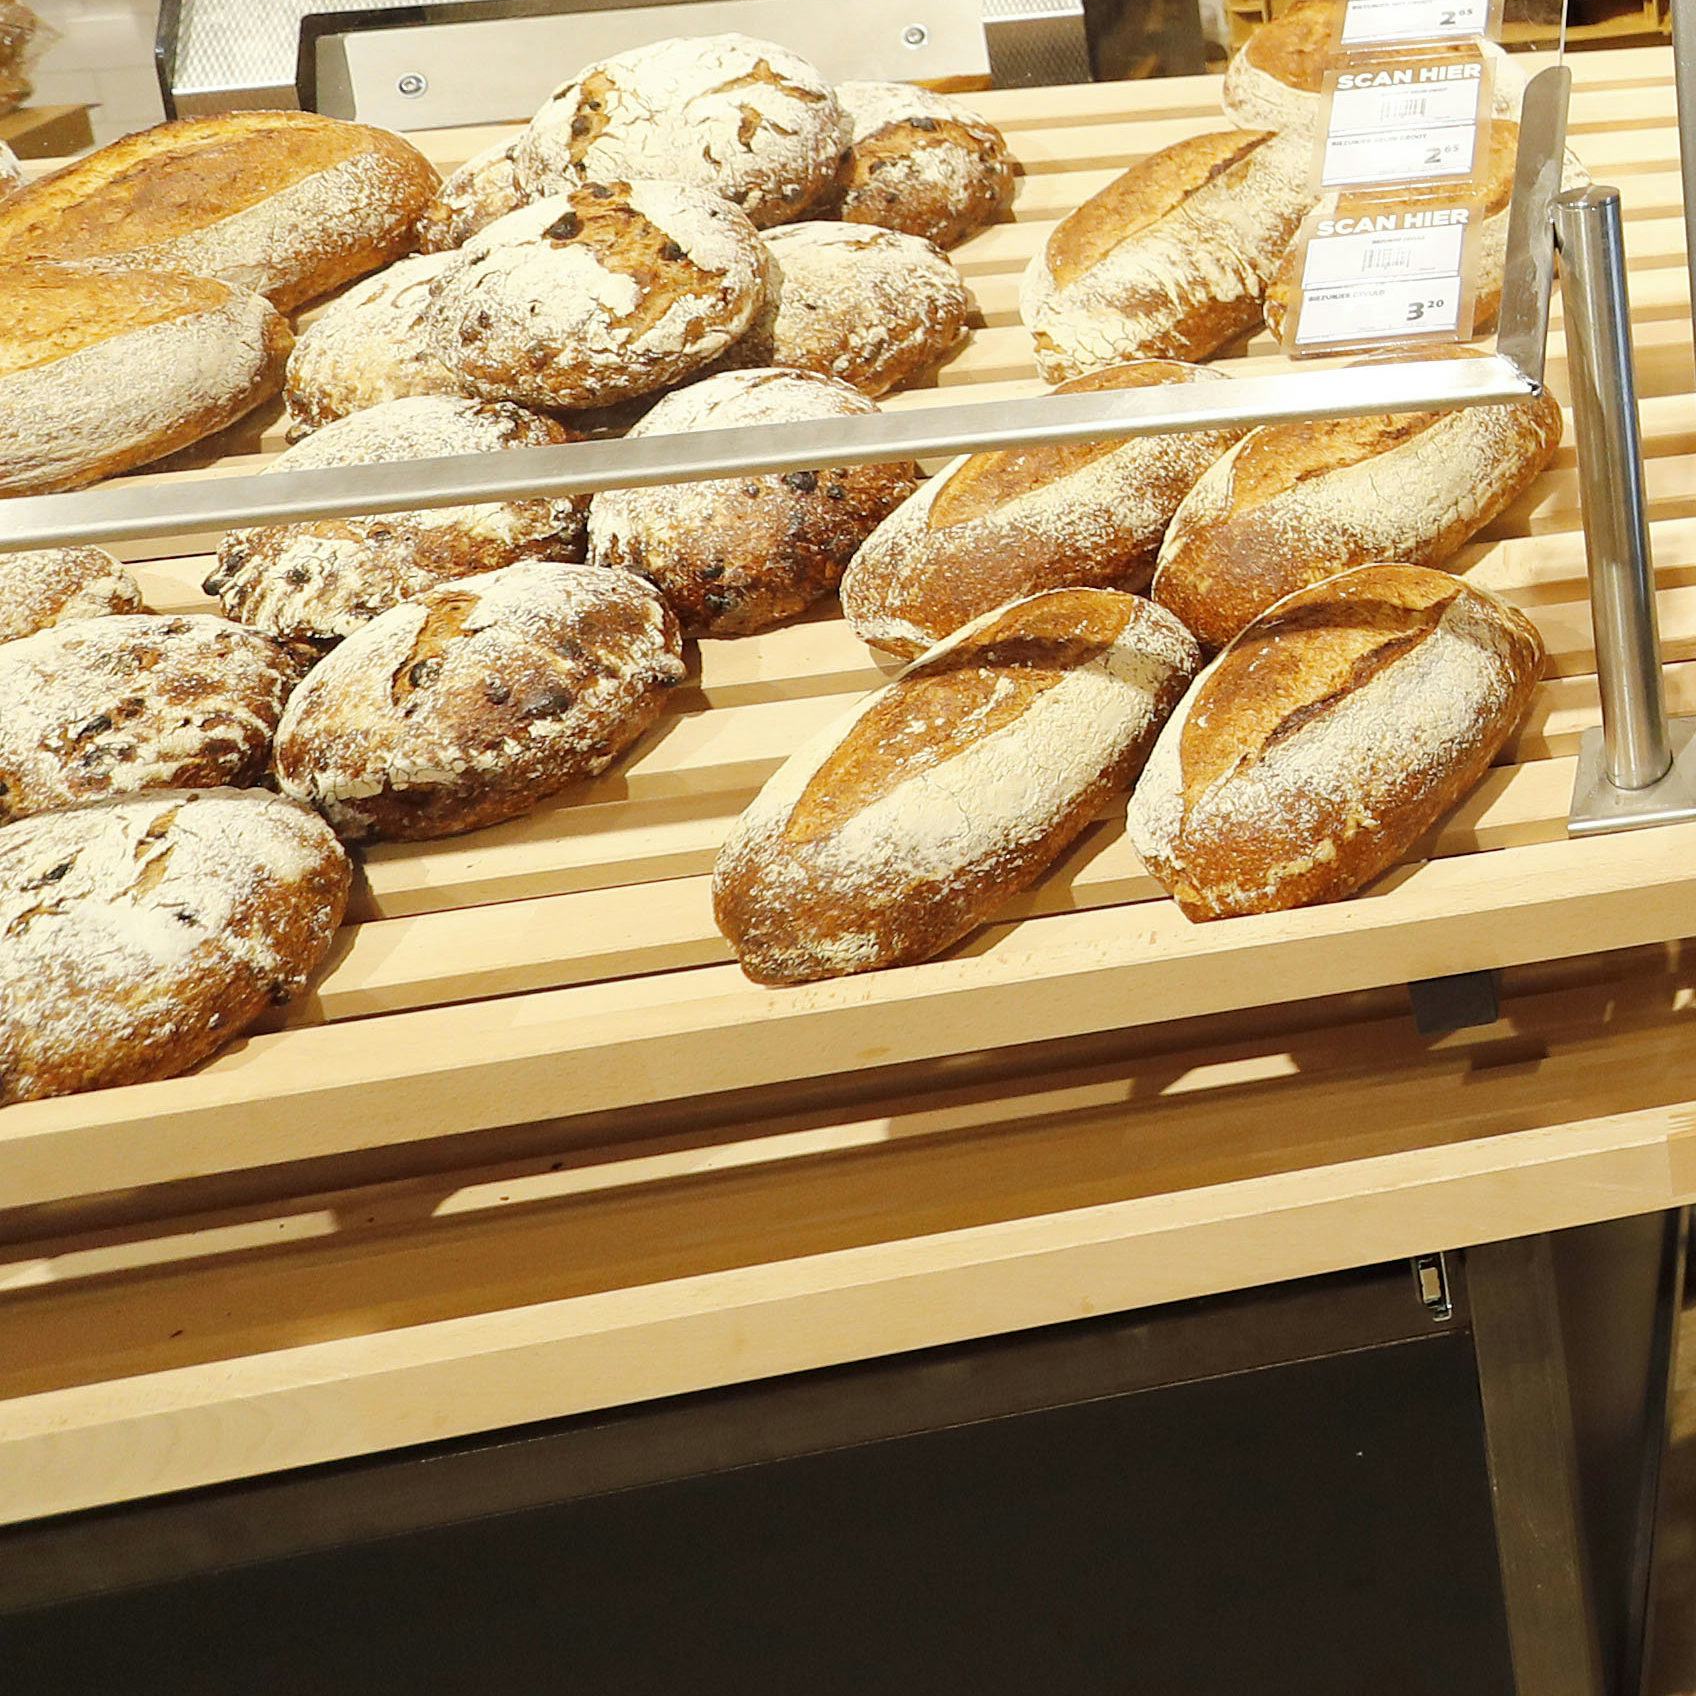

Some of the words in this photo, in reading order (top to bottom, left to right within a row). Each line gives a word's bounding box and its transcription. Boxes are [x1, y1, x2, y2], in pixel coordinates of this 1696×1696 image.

[1439, 11, 1456, 26] 2
[1337, 69, 1413, 90] SCAN
[1419, 63, 1482, 82] HIER
[1424, 148, 1441, 164] 2
[1316, 214, 1397, 236] SCAN
[1403, 208, 1469, 228] HIER
[1406, 302, 1424, 321] 3
[1428, 299, 1445, 309] 20
